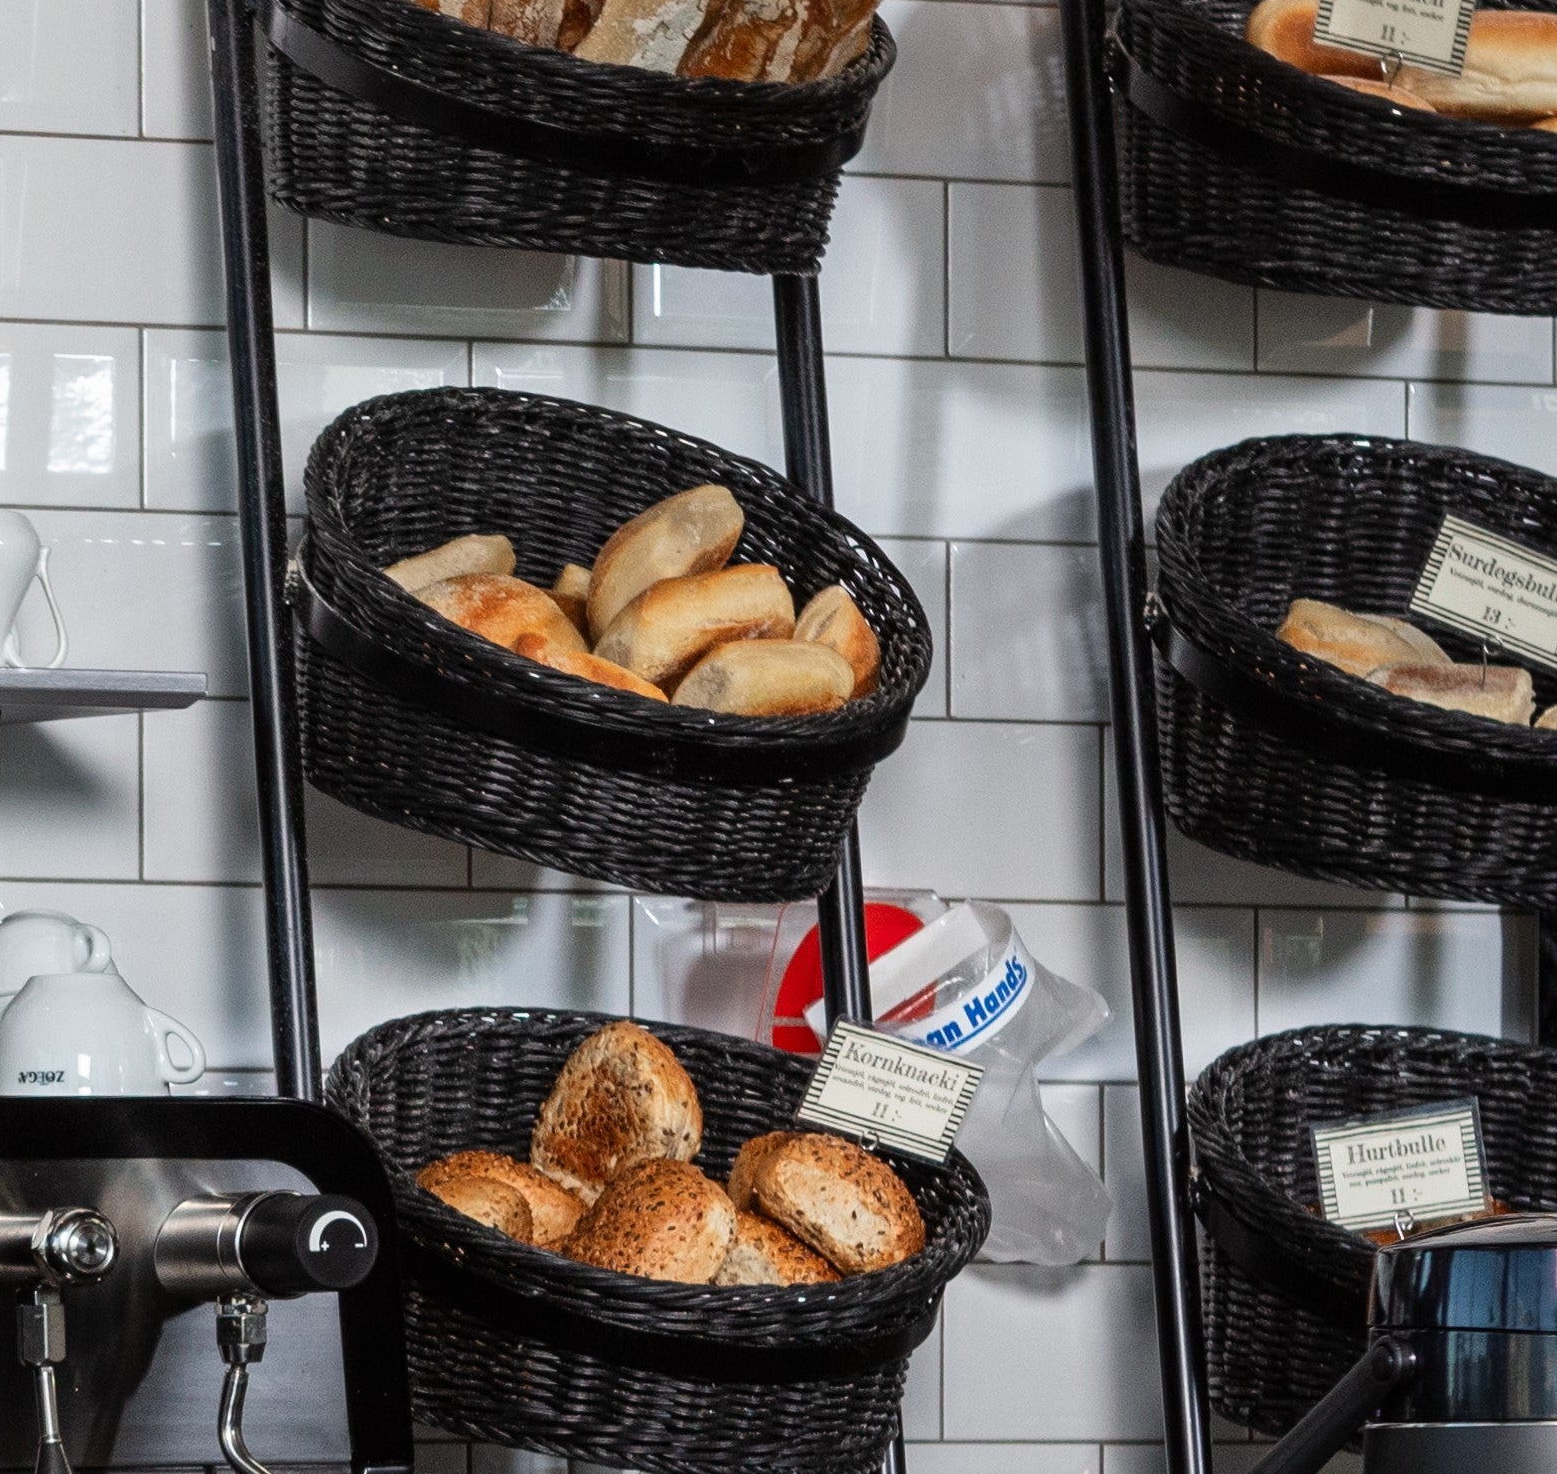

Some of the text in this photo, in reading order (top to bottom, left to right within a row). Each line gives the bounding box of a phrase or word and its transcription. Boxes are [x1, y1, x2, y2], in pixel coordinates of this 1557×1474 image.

[1379, 26, 1396, 41] 11
[963, 955, 1028, 1028] Hands
[845, 1042, 959, 1092] Kornknacki
[1348, 1134, 1446, 1165] Hurtbulle
[1391, 1189, 1406, 1203] 11
